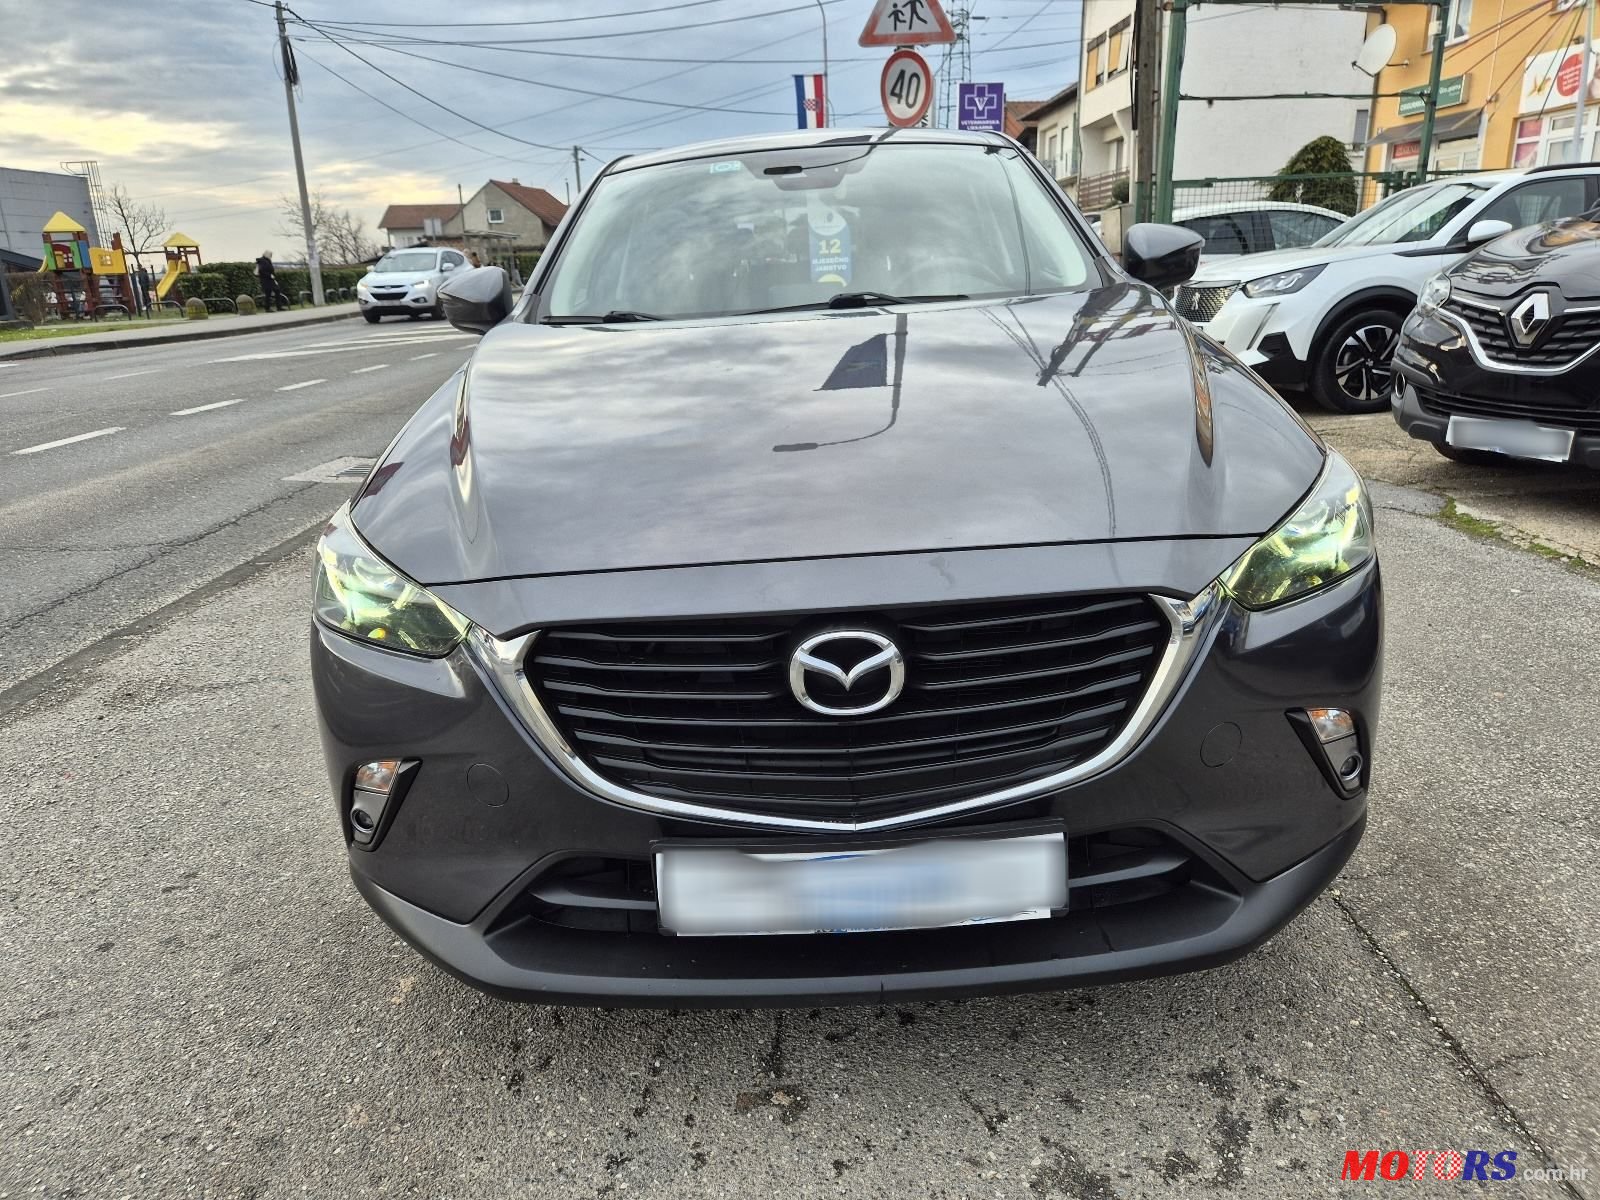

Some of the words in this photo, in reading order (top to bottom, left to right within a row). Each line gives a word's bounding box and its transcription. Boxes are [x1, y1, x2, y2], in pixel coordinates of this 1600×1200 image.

[890, 69, 921, 109] 40
[819, 239, 841, 254] 12
[815, 264, 846, 272] JAMSTVO
